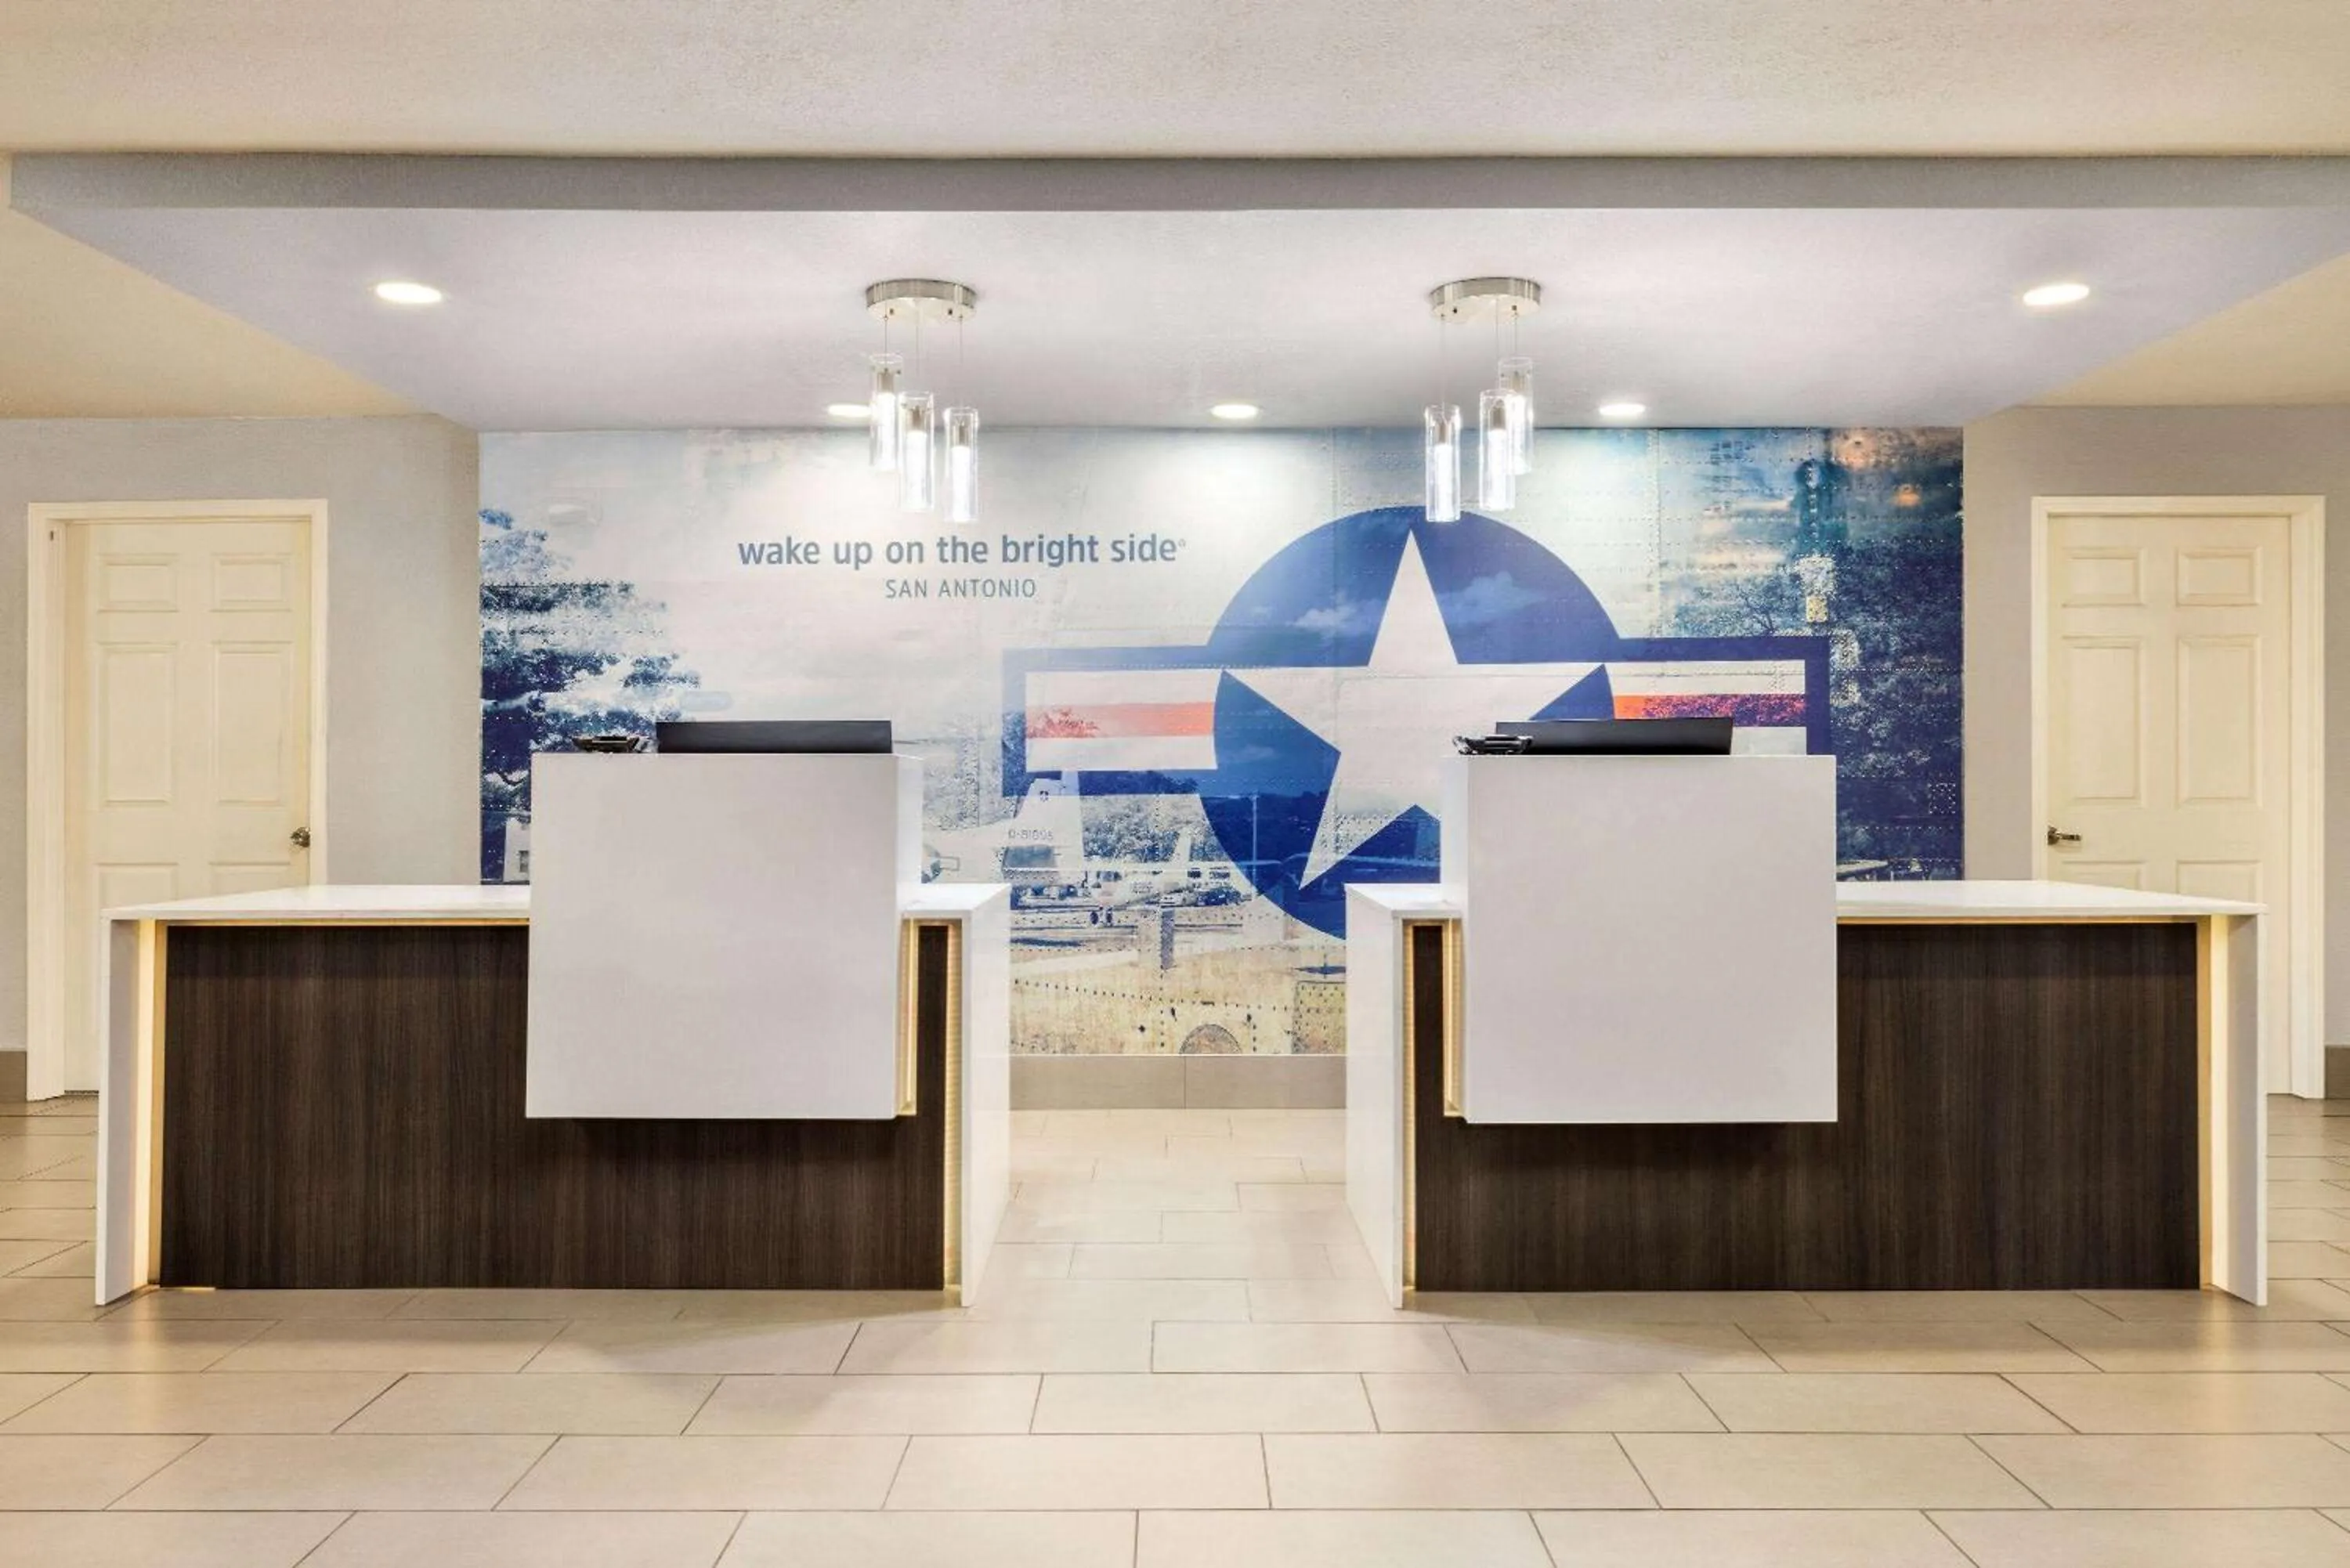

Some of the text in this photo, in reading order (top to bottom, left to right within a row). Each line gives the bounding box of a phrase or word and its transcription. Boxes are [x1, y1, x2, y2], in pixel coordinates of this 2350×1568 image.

[739, 537, 820, 564] wake
[833, 541, 873, 570] up
[885, 540, 924, 564] on
[936, 535, 988, 563] the
[1002, 534, 1099, 568] bright
[886, 579, 1036, 598] SAN ANTONIO
